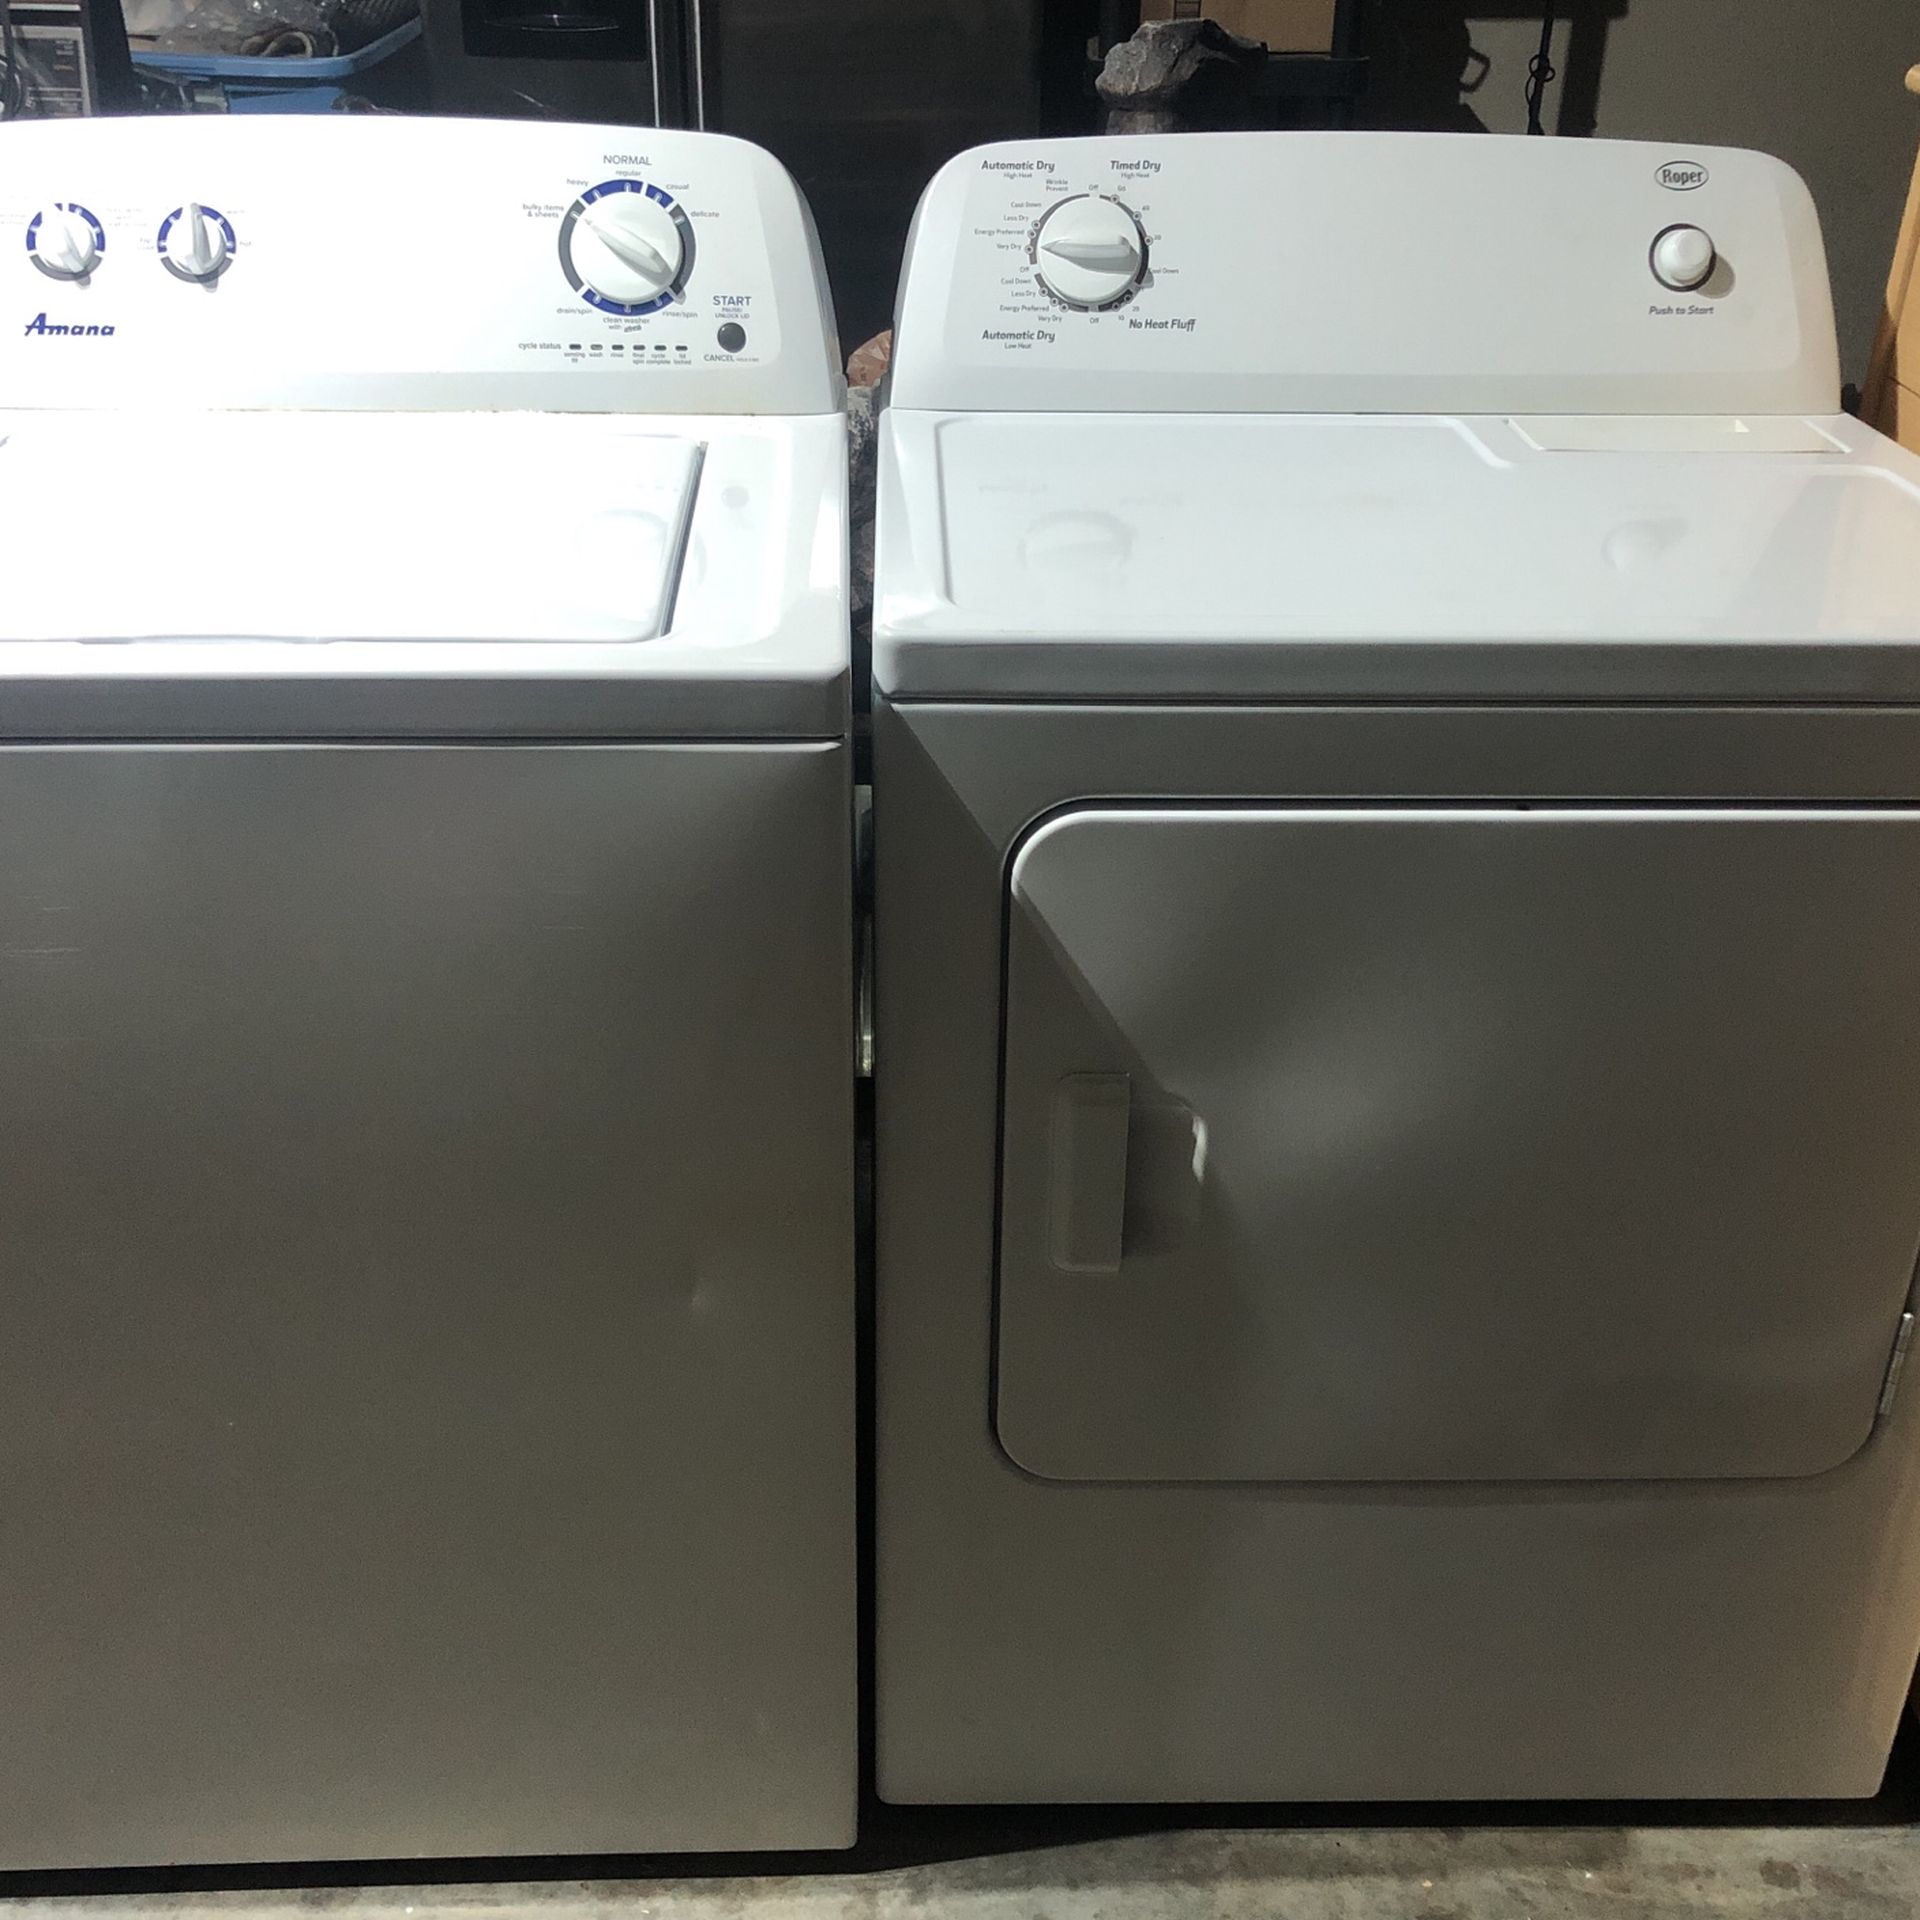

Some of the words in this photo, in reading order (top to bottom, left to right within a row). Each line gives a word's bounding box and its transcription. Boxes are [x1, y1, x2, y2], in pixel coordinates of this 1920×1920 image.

[603, 155, 652, 165] NORMAL
[981, 160, 1034, 170] Automatic
[1036, 160, 1055, 173] Dry
[1110, 160, 1140, 170] Timed
[1142, 160, 1161, 172] Dry
[1662, 169, 1703, 185] Roper
[566, 178, 588, 187] heavy
[522, 203, 542, 211] bulky
[544, 203, 564, 211] items
[535, 210, 559, 218] sheets
[690, 210, 720, 218] delicate
[712, 295, 752, 306] START
[999, 304, 1021, 312] Energy
[1021, 304, 1049, 312] Preferred
[1649, 305, 1673, 315] Push
[1675, 306, 1686, 314] to
[1687, 305, 1714, 315] Start
[602, 316, 622, 324] clean
[623, 316, 650, 324] washer
[1038, 315, 1051, 323] Very
[24, 312, 116, 336] Amana
[1129, 318, 1143, 329] No
[1144, 318, 1169, 329] Heat
[1170, 318, 1196, 332] Fluff
[982, 330, 1035, 341] Automatic
[1036, 330, 1056, 343] Dry
[518, 343, 538, 351] cycle
[703, 354, 735, 362] CANCEL
